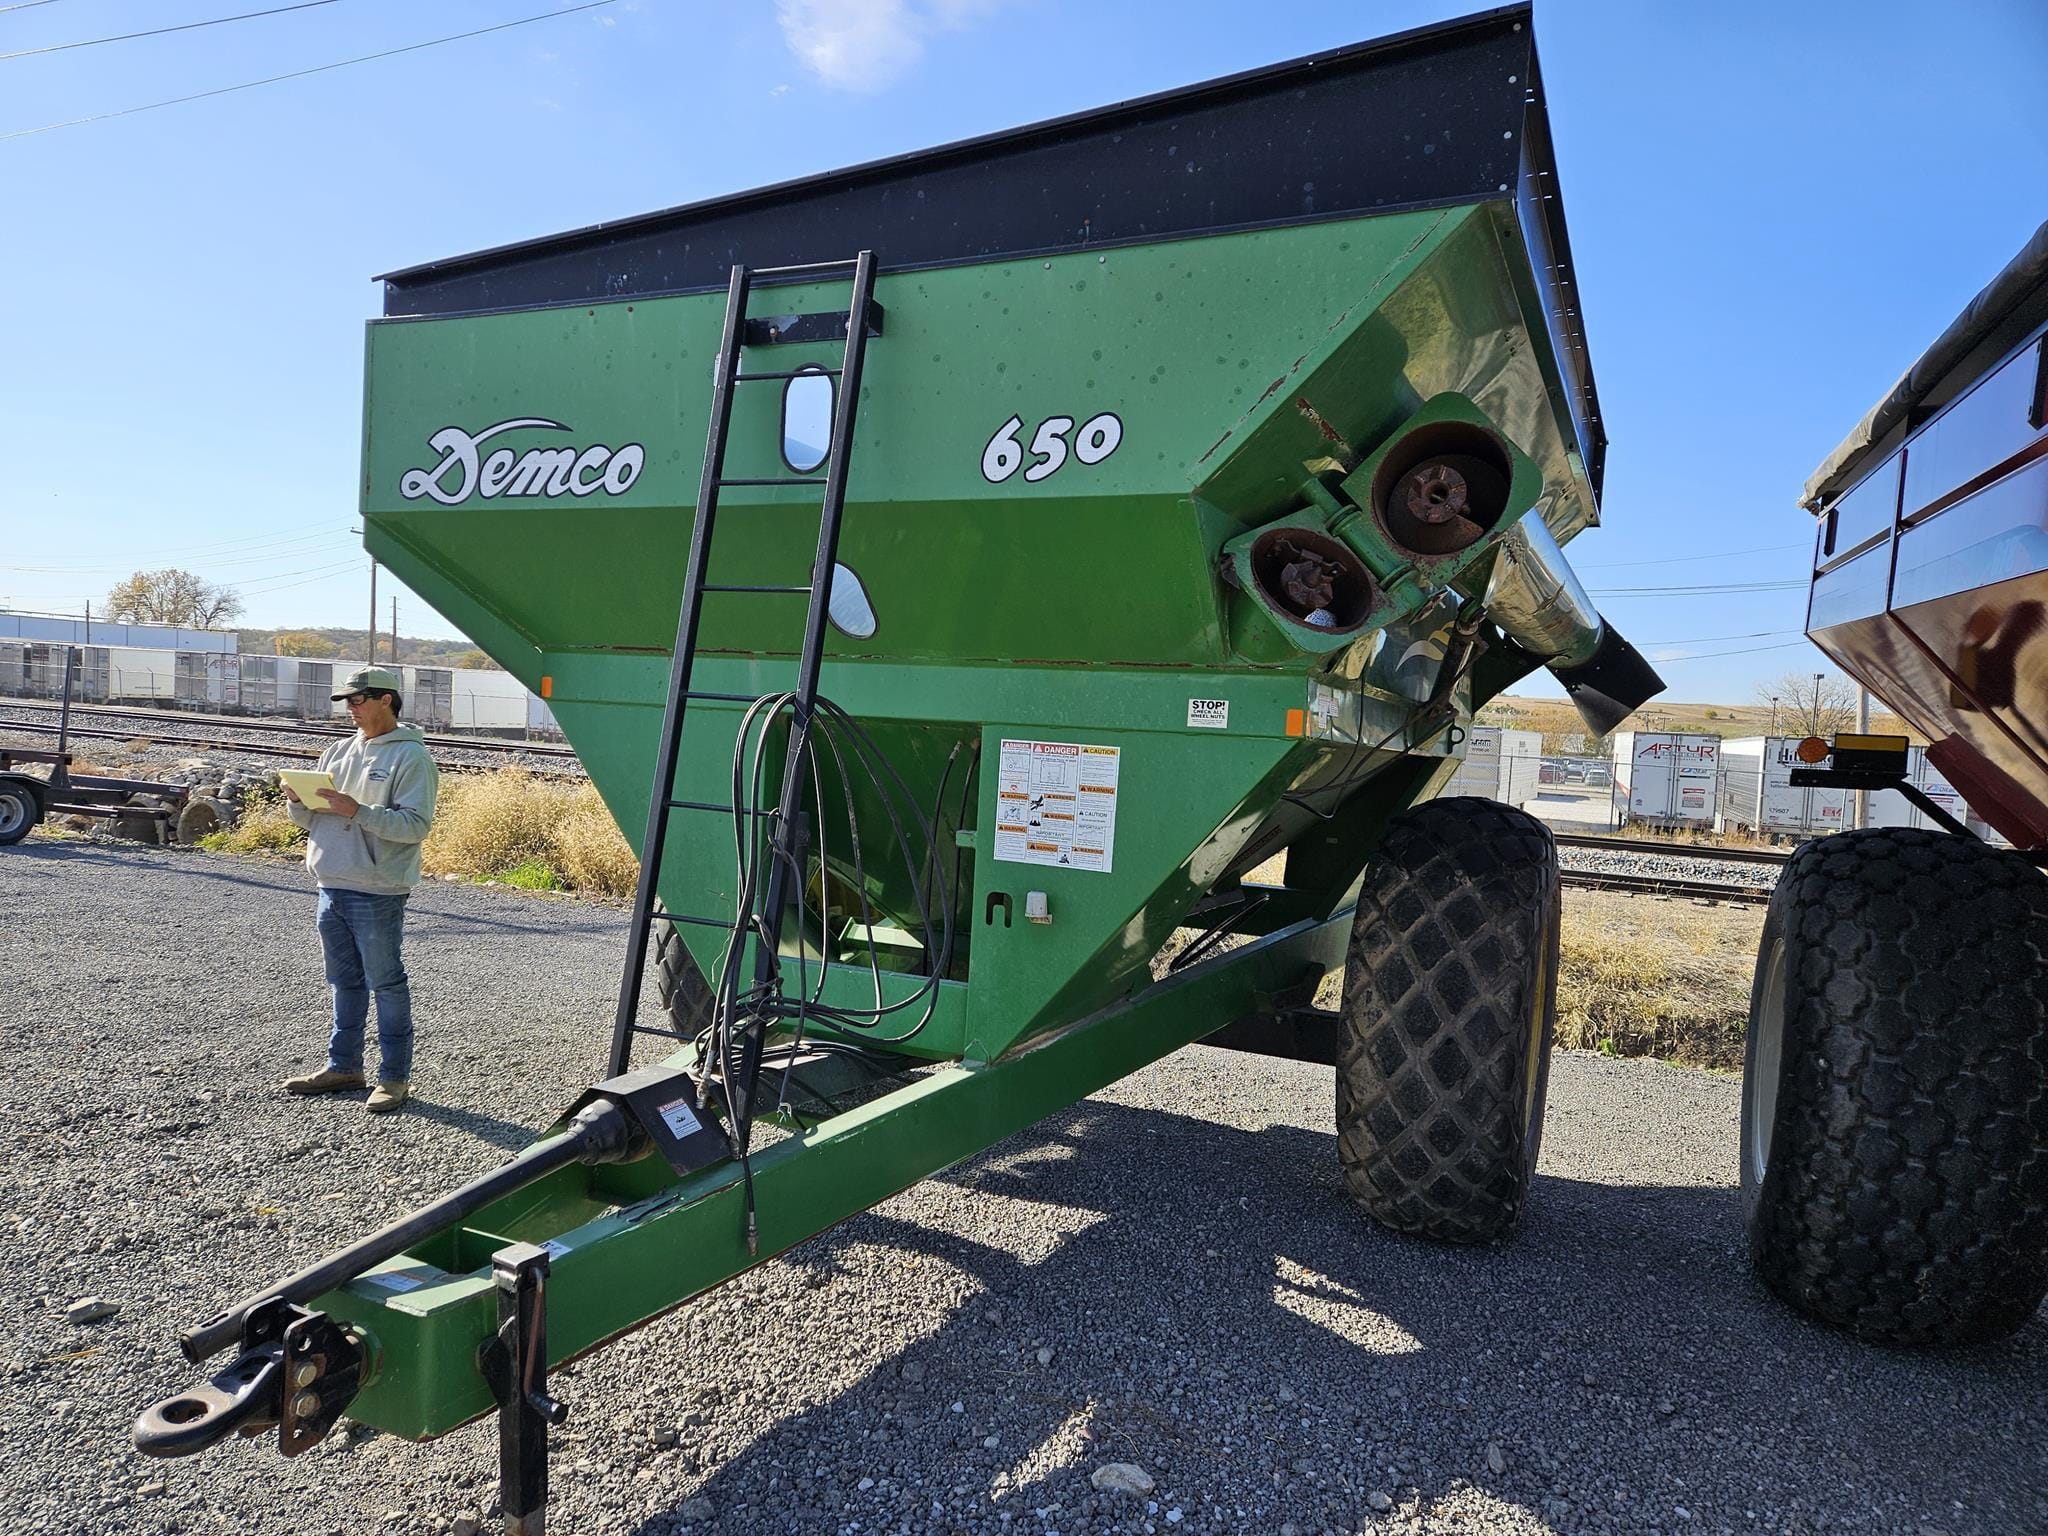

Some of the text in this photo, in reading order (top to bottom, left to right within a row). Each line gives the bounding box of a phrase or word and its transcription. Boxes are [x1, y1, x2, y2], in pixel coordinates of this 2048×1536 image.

[981, 412, 1123, 483] 650
[400, 417, 646, 506] Demco
[1192, 700, 1225, 710] STOP!
[1044, 745, 1077, 755] DANGER
[1639, 742, 1715, 758] ARTUR
